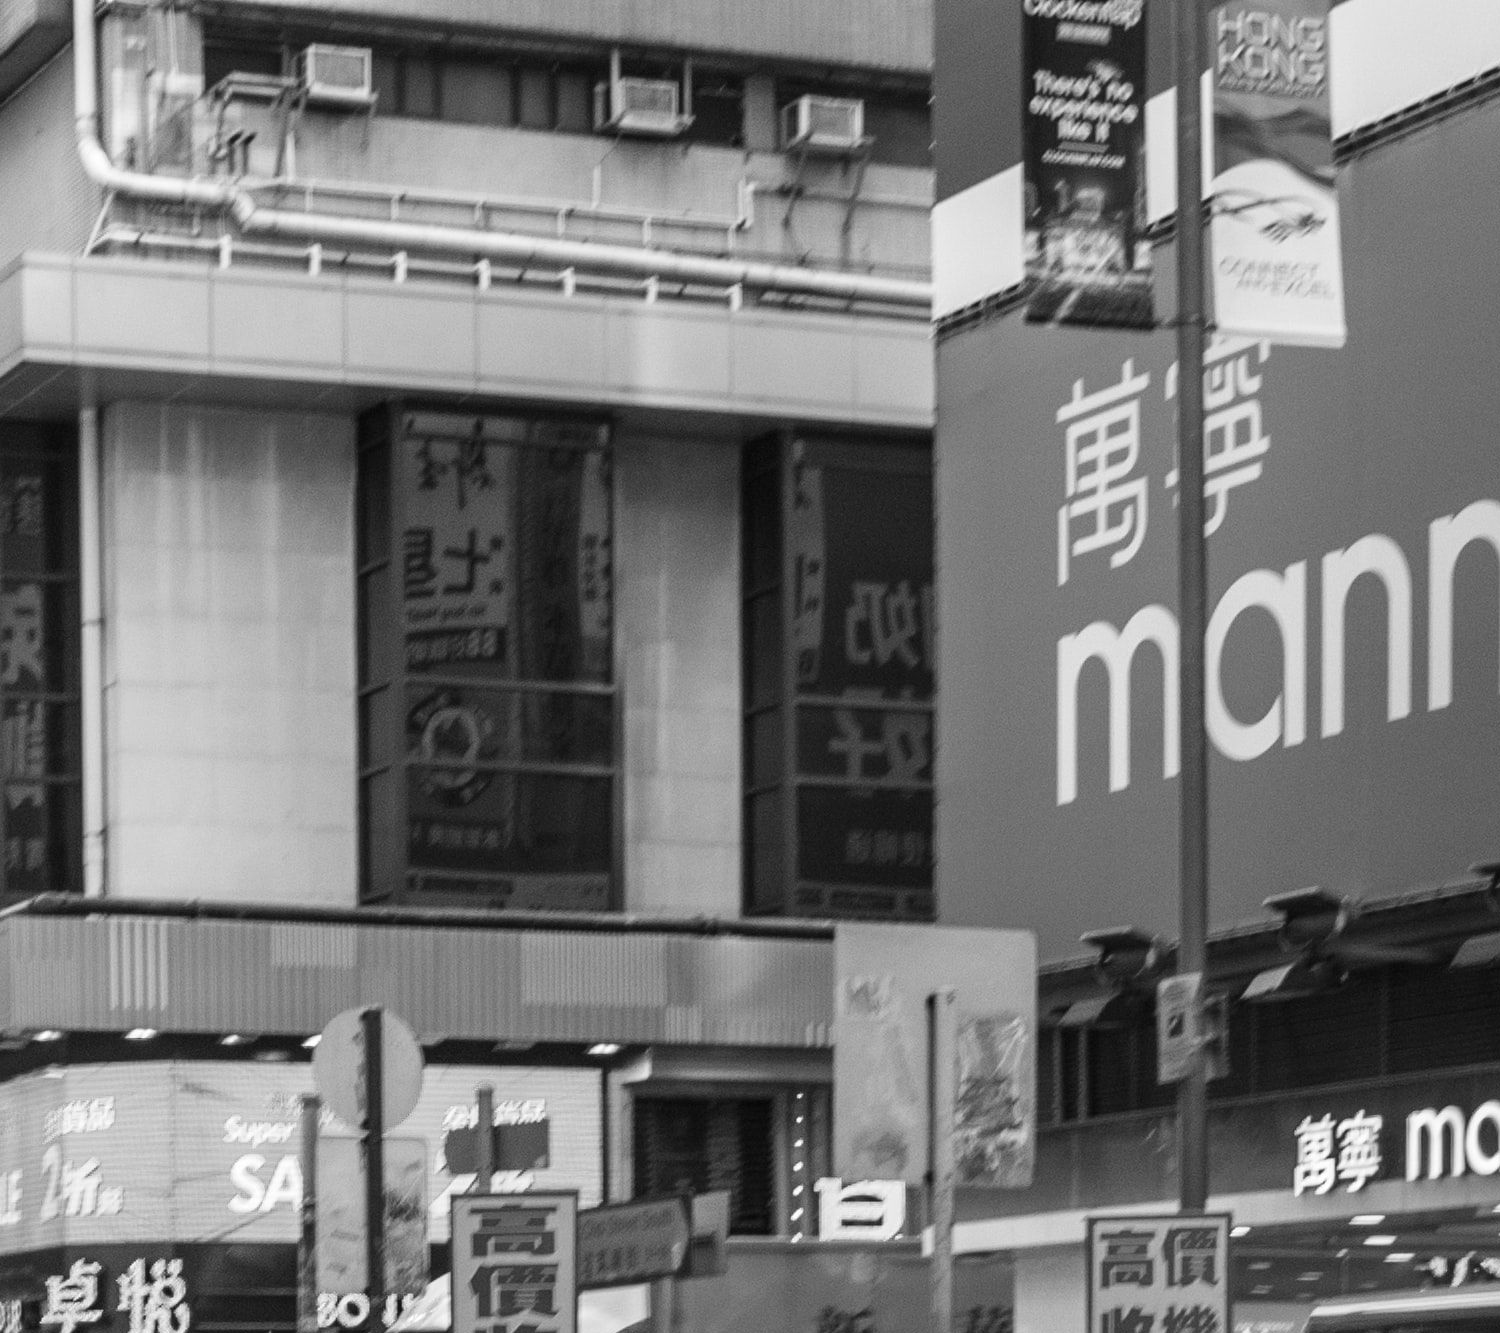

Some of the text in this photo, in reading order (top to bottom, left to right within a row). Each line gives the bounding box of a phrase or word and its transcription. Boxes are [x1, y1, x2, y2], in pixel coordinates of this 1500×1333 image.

[1217, 6, 1325, 52] HONG
[1218, 40, 1326, 86] KONG
[227, 1152, 304, 1214] SA
[1294, 1108, 1383, 1197] 萬寧
[1101, 1226, 1223, 1290] 高價
